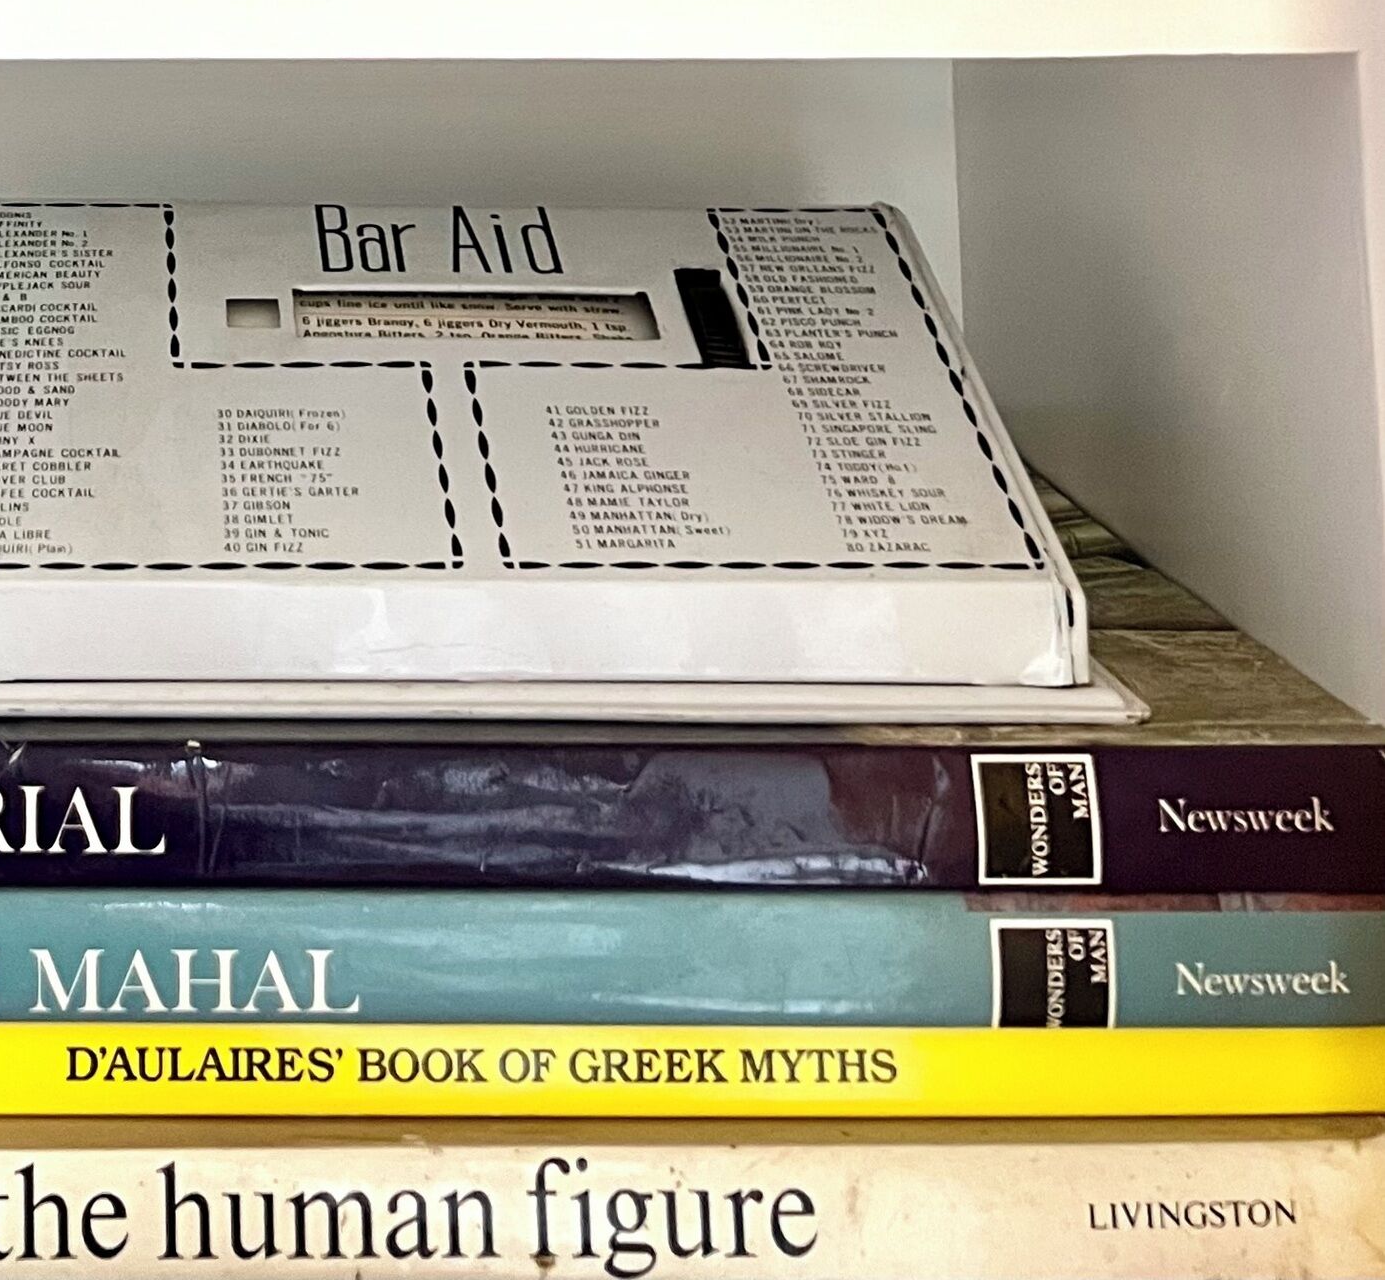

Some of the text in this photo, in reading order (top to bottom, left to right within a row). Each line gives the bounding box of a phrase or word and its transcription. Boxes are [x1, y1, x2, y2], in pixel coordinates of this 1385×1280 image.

[314, 203, 564, 274] Bar Aid
[60, 448, 122, 458] COCKTAIL
[574, 444, 645, 454] HURRICANE
[244, 501, 290, 510] GIBSON
[14, 530, 52, 539] LIBRE
[598, 539, 675, 549] MARGARITA
[1071, 762, 1089, 819] MAN
[1028, 762, 1050, 877] WONDERS
[1158, 797, 1335, 835] Newsweek
[29, 948, 360, 1015] MAHAL
[1175, 960, 1351, 997] Newsweek
[358, 1048, 485, 1085] BOOK
[499, 1050, 554, 1083] OF
[569, 1048, 728, 1085] GREEK
[739, 1048, 898, 1085] MYTHS
[156, 1160, 497, 1262] human
[529, 1157, 819, 1278] figure
[1087, 1198, 1298, 1232] LIVINGSTON
